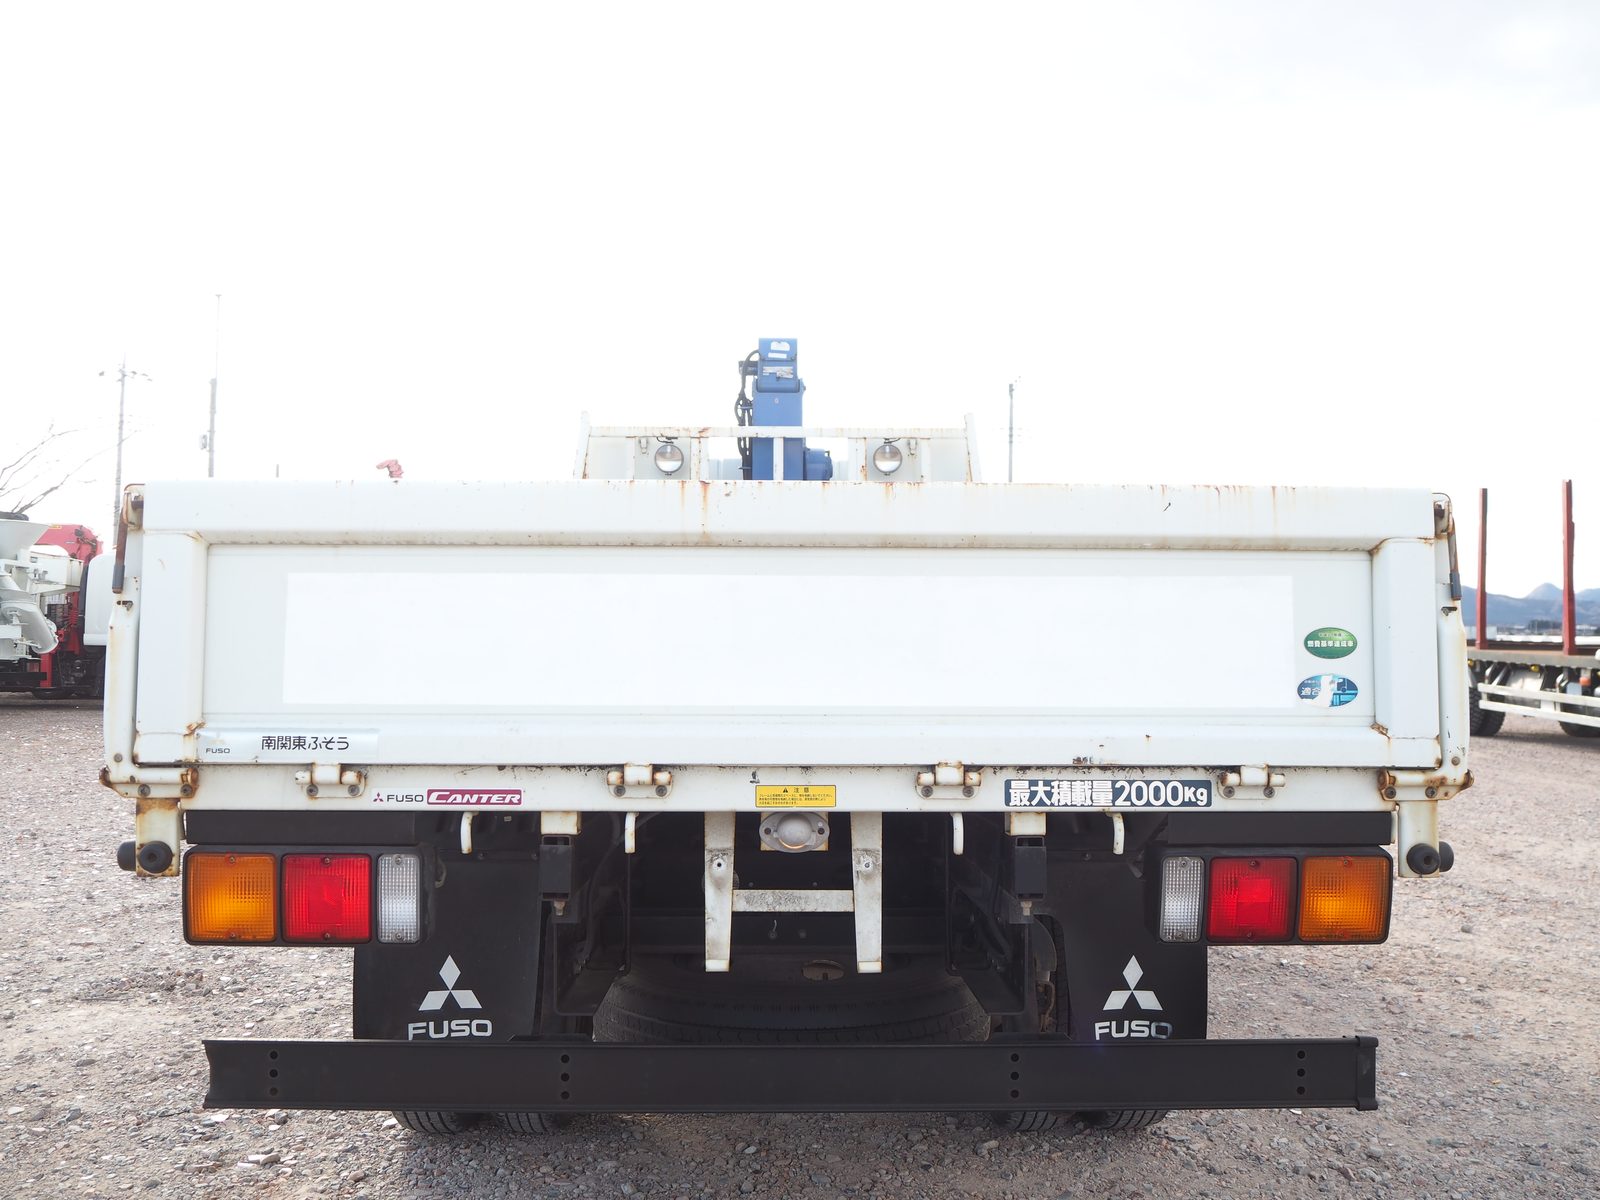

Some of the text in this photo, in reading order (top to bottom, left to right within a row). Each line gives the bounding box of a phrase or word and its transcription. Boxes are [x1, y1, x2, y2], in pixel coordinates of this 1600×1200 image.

[261, 736, 350, 750] 南関東ふそう
[386, 791, 521, 804] FUSO CANTER
[408, 1019, 493, 1041] FUSO
[1094, 1020, 1172, 1040] FUSO
